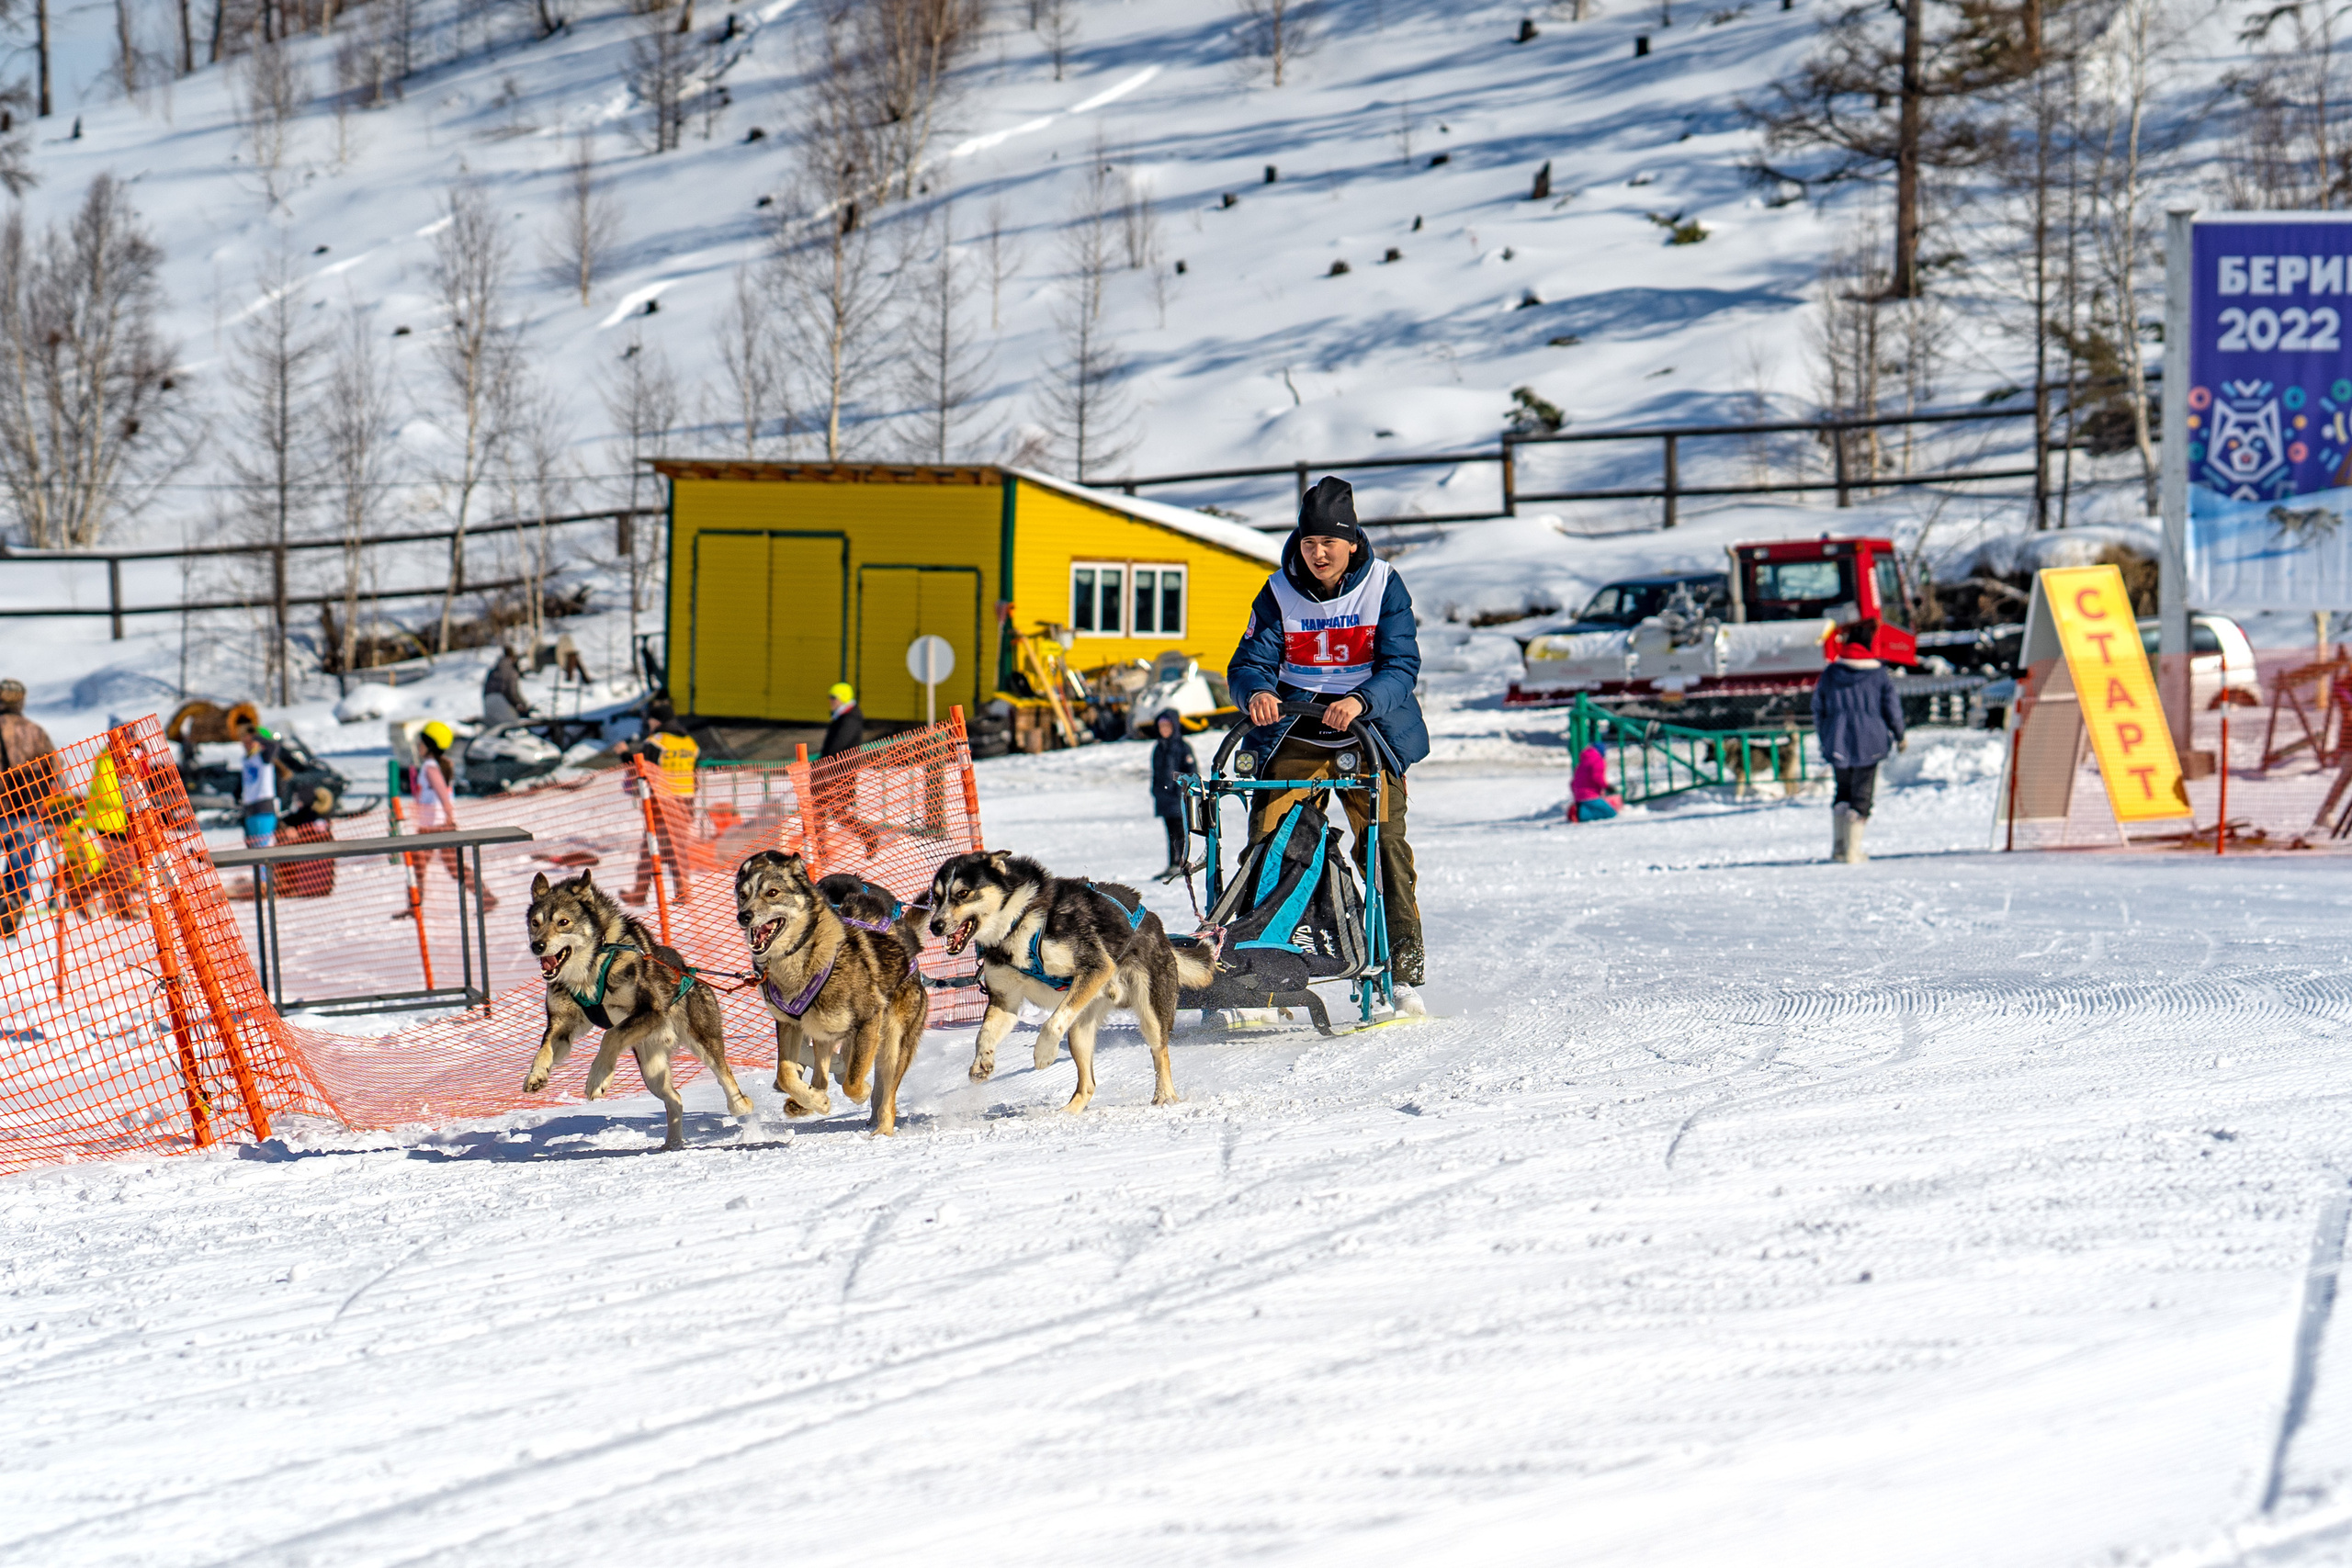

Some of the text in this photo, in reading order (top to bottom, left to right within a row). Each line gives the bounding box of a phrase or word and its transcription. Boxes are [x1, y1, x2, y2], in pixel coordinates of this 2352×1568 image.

[2217, 254, 2352, 296] БЕРИ
[2216, 306, 2342, 353] 2022
[2075, 587, 2156, 800] СТАРТ
